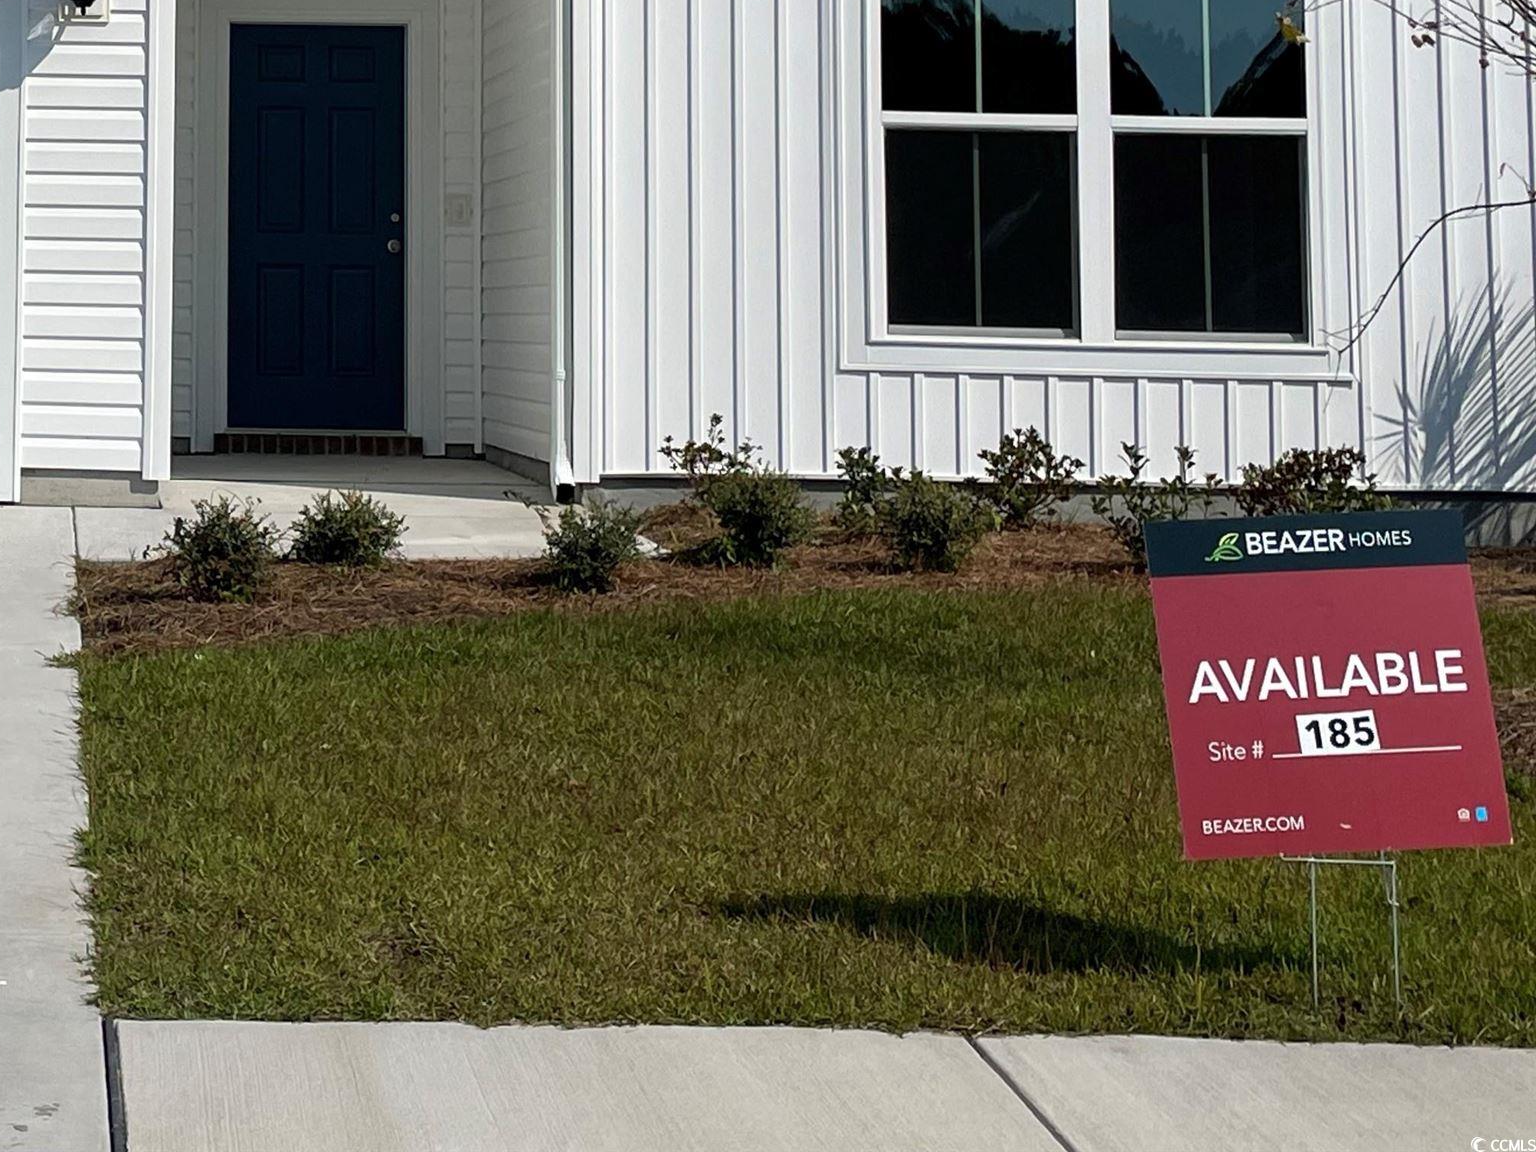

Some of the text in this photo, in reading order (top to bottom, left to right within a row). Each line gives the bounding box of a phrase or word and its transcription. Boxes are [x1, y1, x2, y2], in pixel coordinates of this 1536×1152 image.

[1245, 529, 1412, 556] BEAZER HOMES
[1188, 649, 1468, 704] AVAILABLE
[1305, 716, 1375, 749] 185
[1202, 816, 1305, 835] BEAZER.COM
